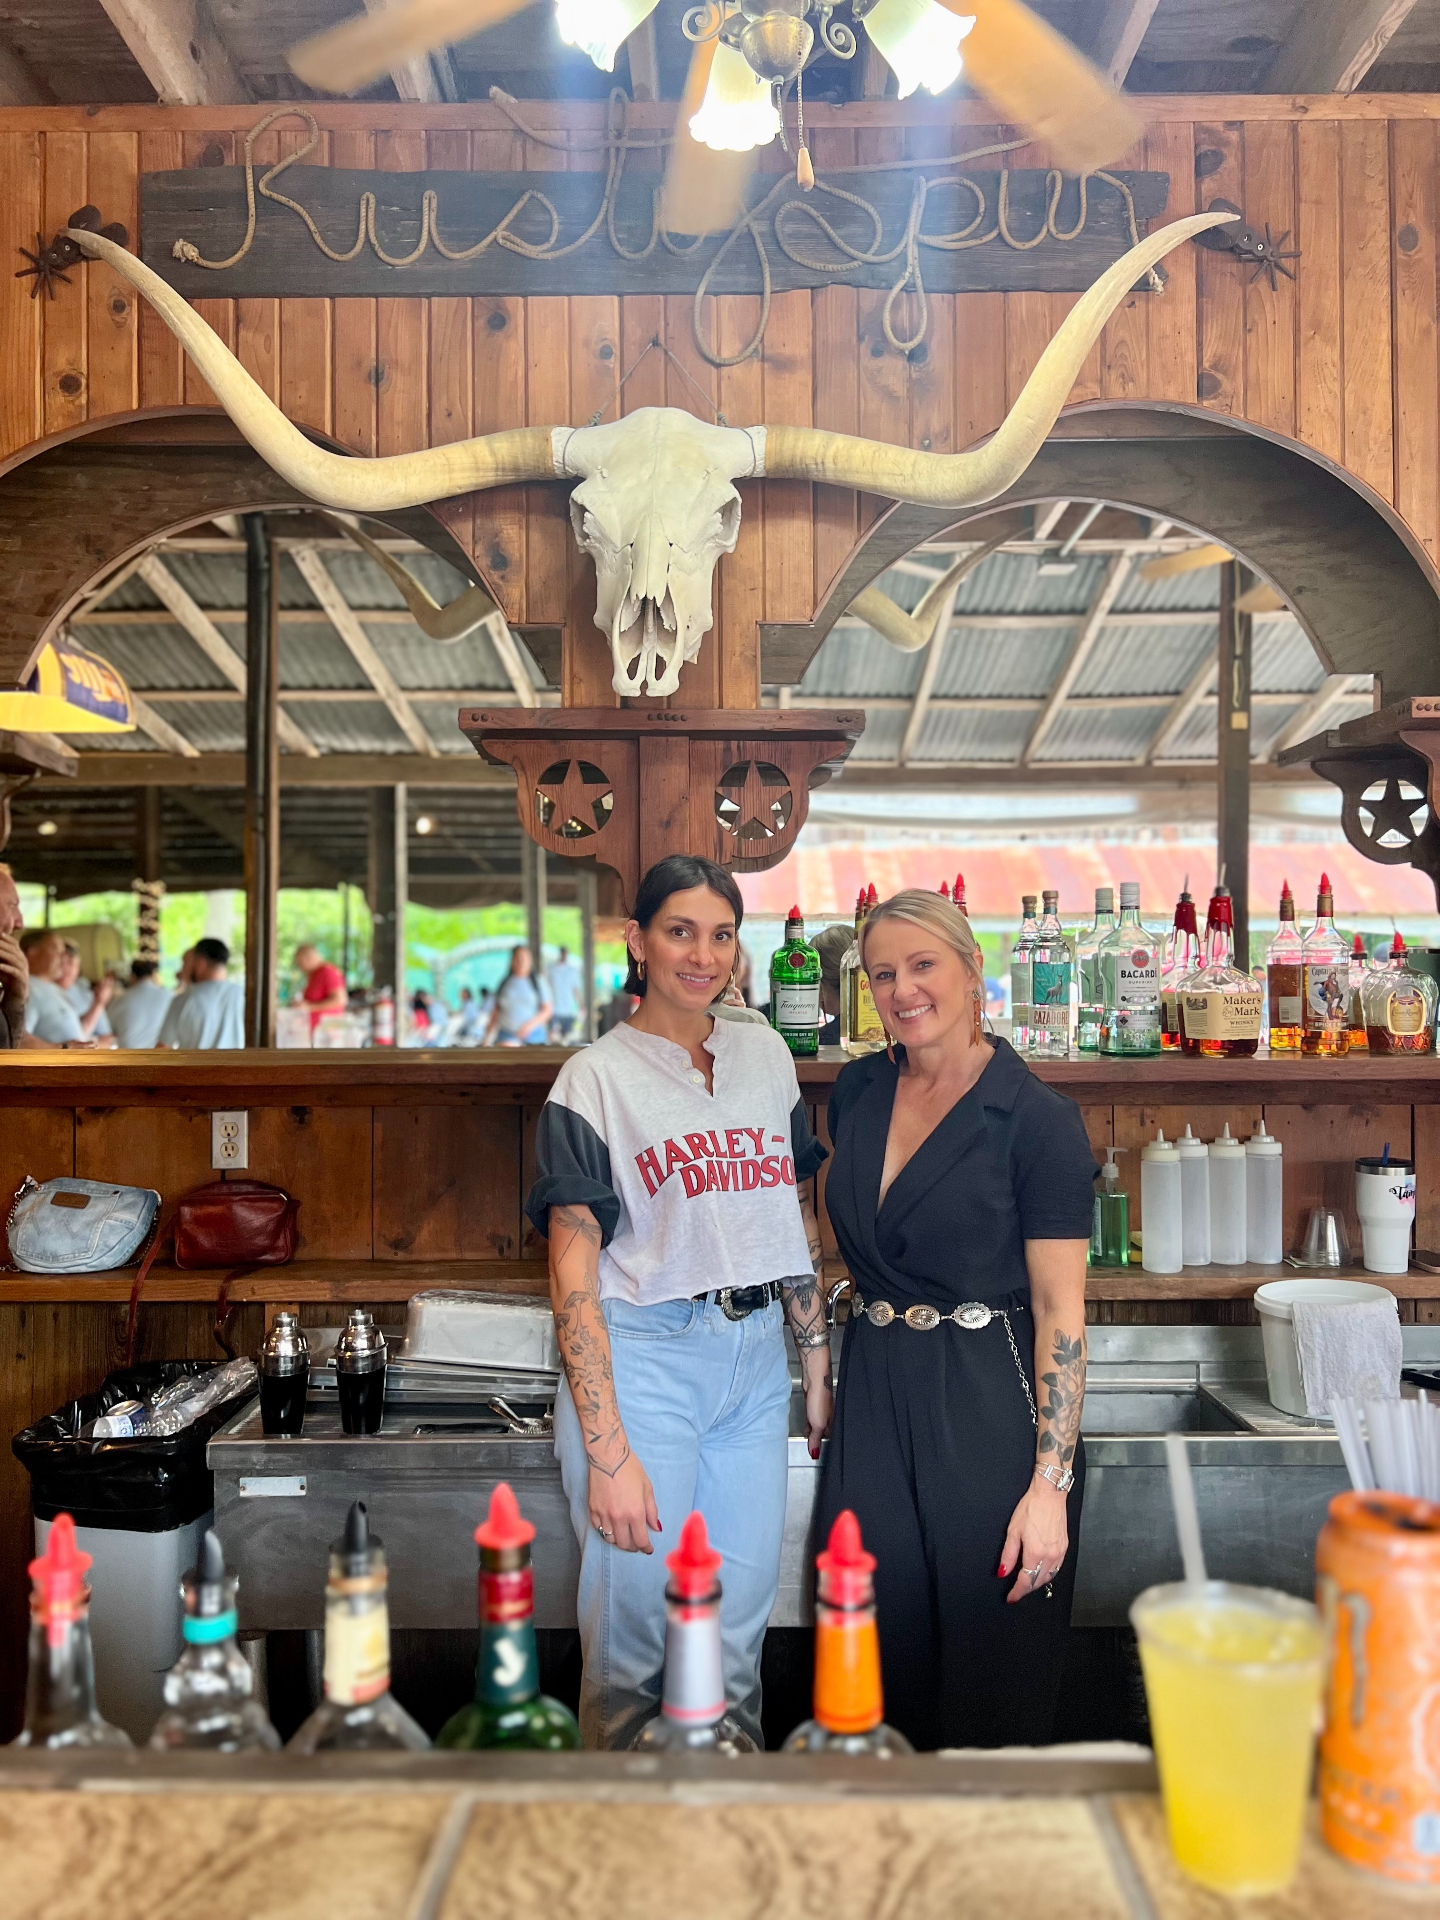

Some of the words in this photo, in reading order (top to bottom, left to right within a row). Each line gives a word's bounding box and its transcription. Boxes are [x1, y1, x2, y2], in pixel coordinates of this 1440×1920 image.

[780, 1000, 815, 1010] Tanqueray
[1222, 996, 1262, 1005] Maker's
[1234, 1006, 1260, 1016] Mark
[678, 1155, 795, 1198] DAVIDSO
